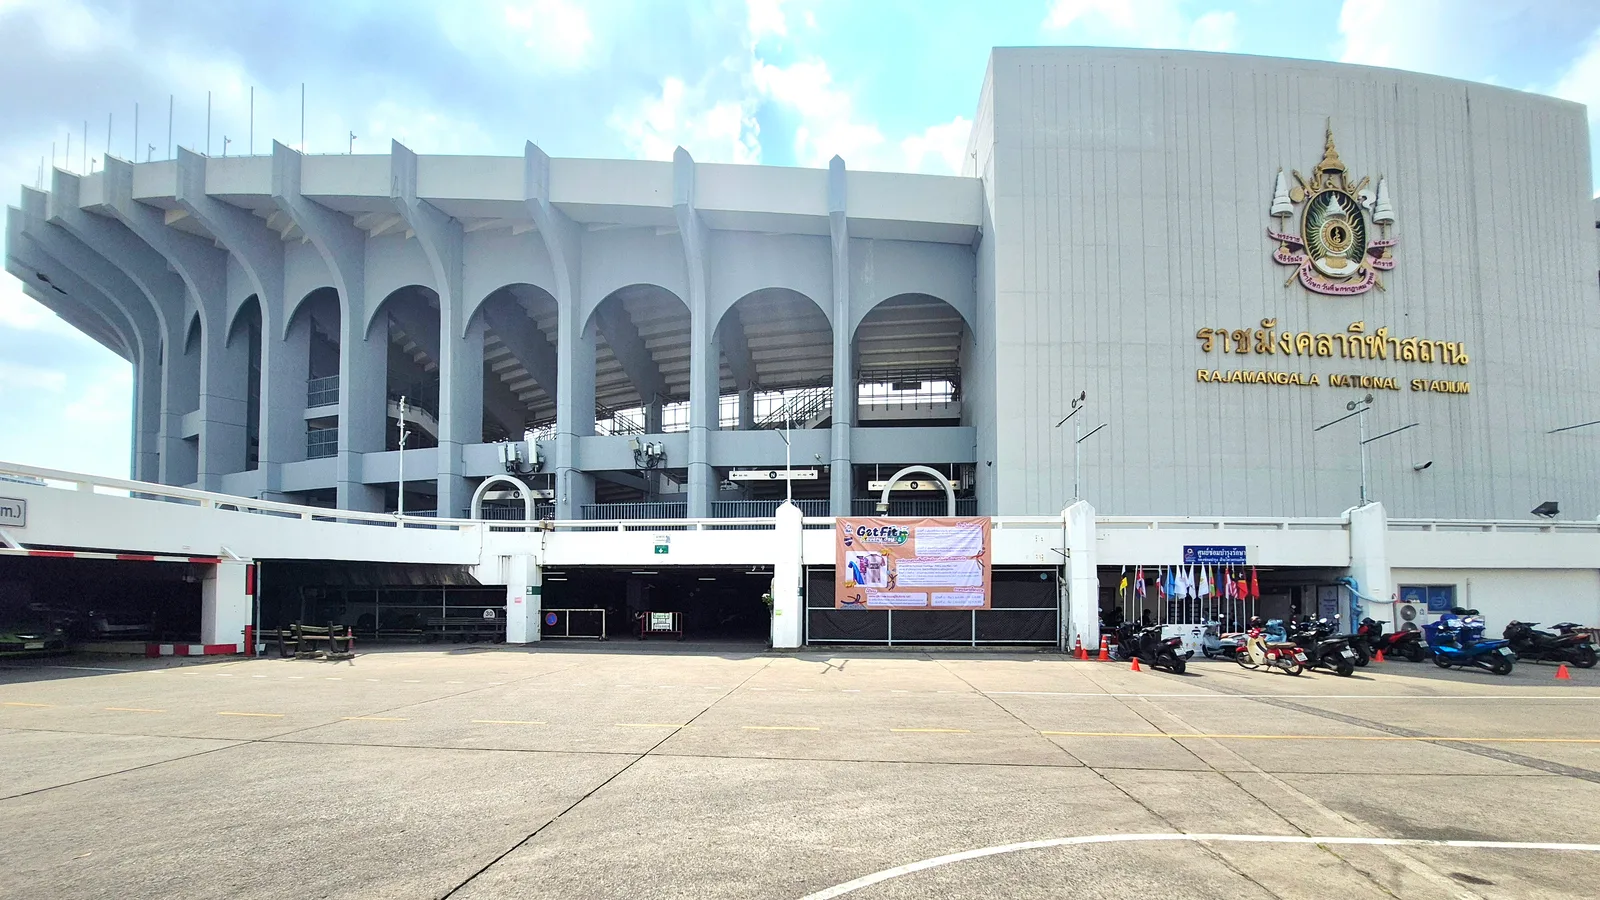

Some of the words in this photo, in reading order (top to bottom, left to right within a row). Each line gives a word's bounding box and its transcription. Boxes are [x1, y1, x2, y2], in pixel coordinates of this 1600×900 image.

[1196, 318, 1469, 365] ราชมังคลากีฬาสถาน
[1196, 369, 1320, 386] RAJAMANGALA
[1328, 373, 1401, 390] NATIONAL
[1410, 379, 1470, 394] STADIUM
[856, 526, 879, 537] Get
[880, 526, 898, 537] Fit
[1197, 548, 1246, 558] ศูนย์ซ่อมบำรุงรักษา
